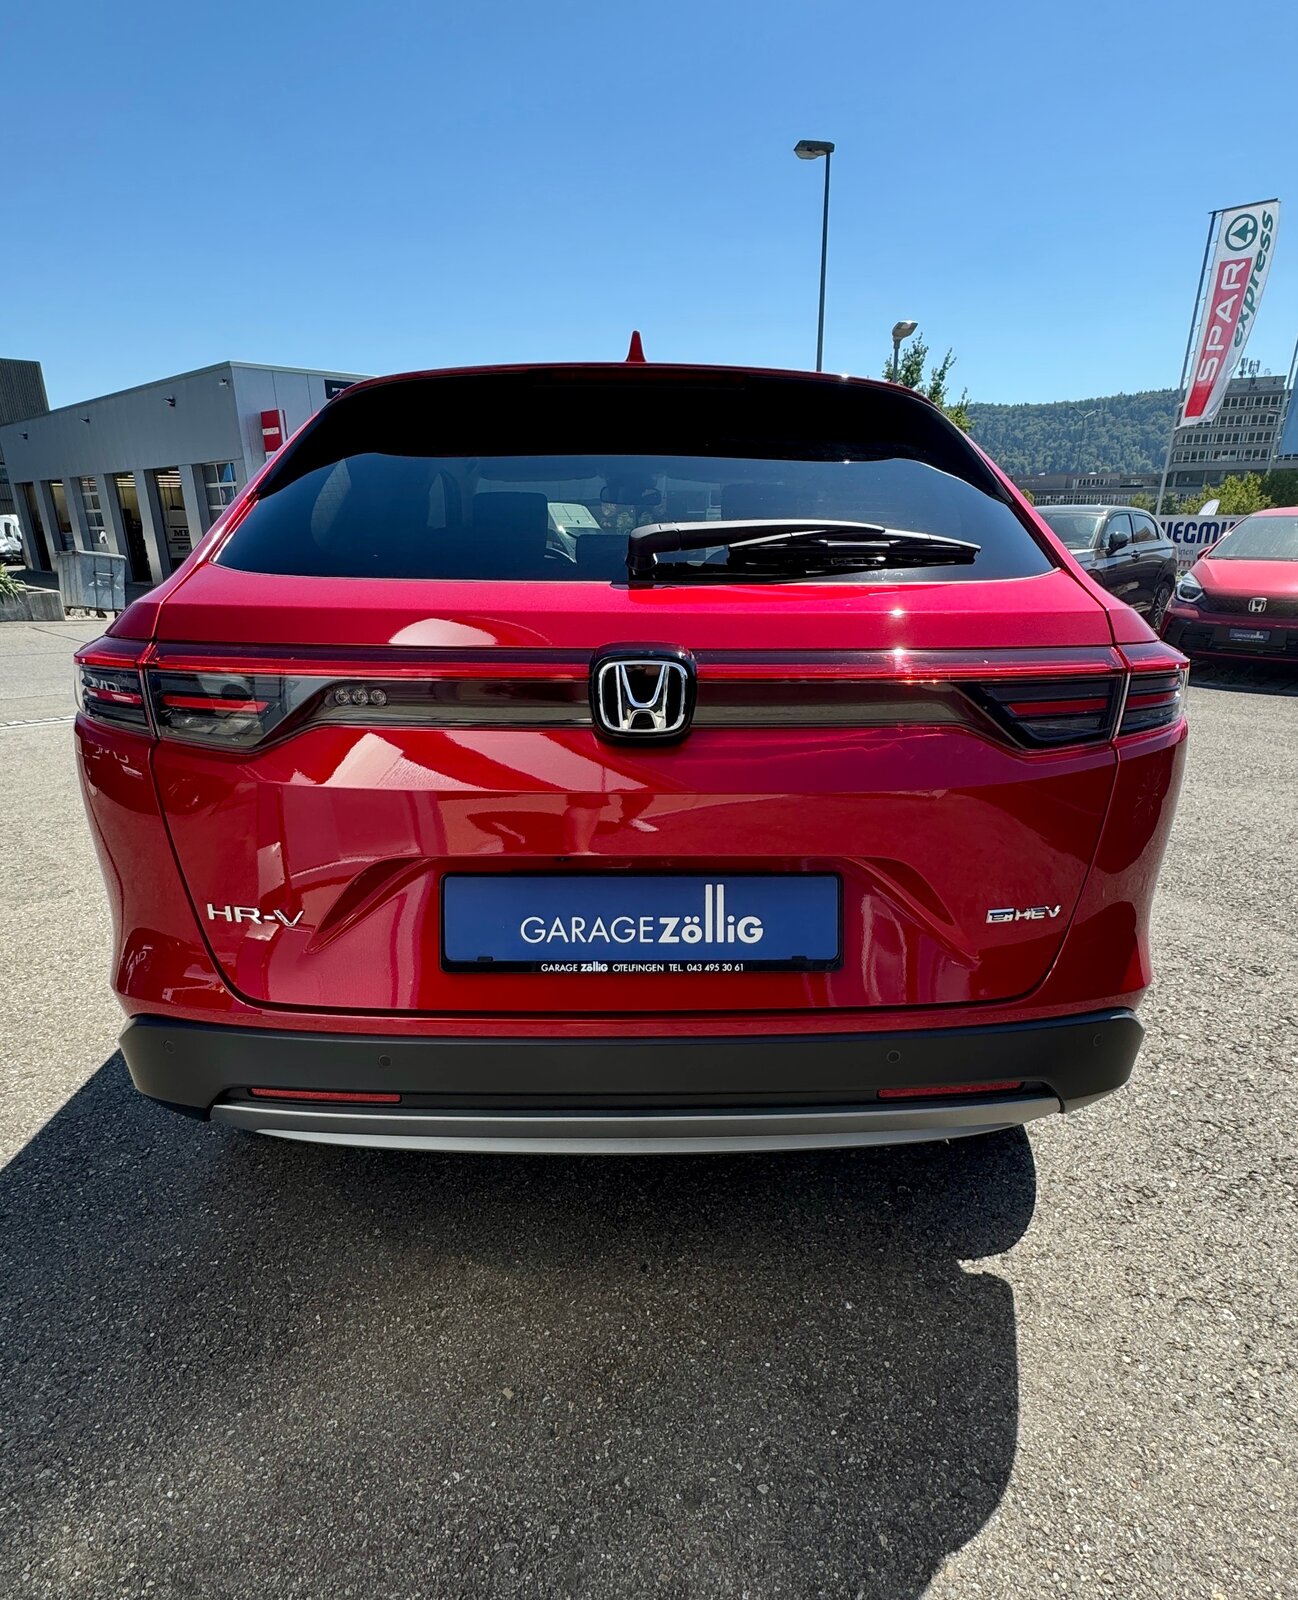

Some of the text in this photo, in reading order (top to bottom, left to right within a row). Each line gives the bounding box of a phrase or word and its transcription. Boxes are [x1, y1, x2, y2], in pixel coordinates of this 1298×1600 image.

[1233, 210, 1274, 348] express
[1197, 261, 1247, 383] SPAR
[206, 903, 304, 927] HR-V
[520, 916, 654, 943] GARAGE
[541, 963, 578, 972] GARAGE
[612, 963, 664, 972] OTELFINGEN
[686, 963, 702, 972] 043
[704, 963, 720, 972] 495
[722, 963, 732, 972] 30
[734, 963, 744, 972] 61
